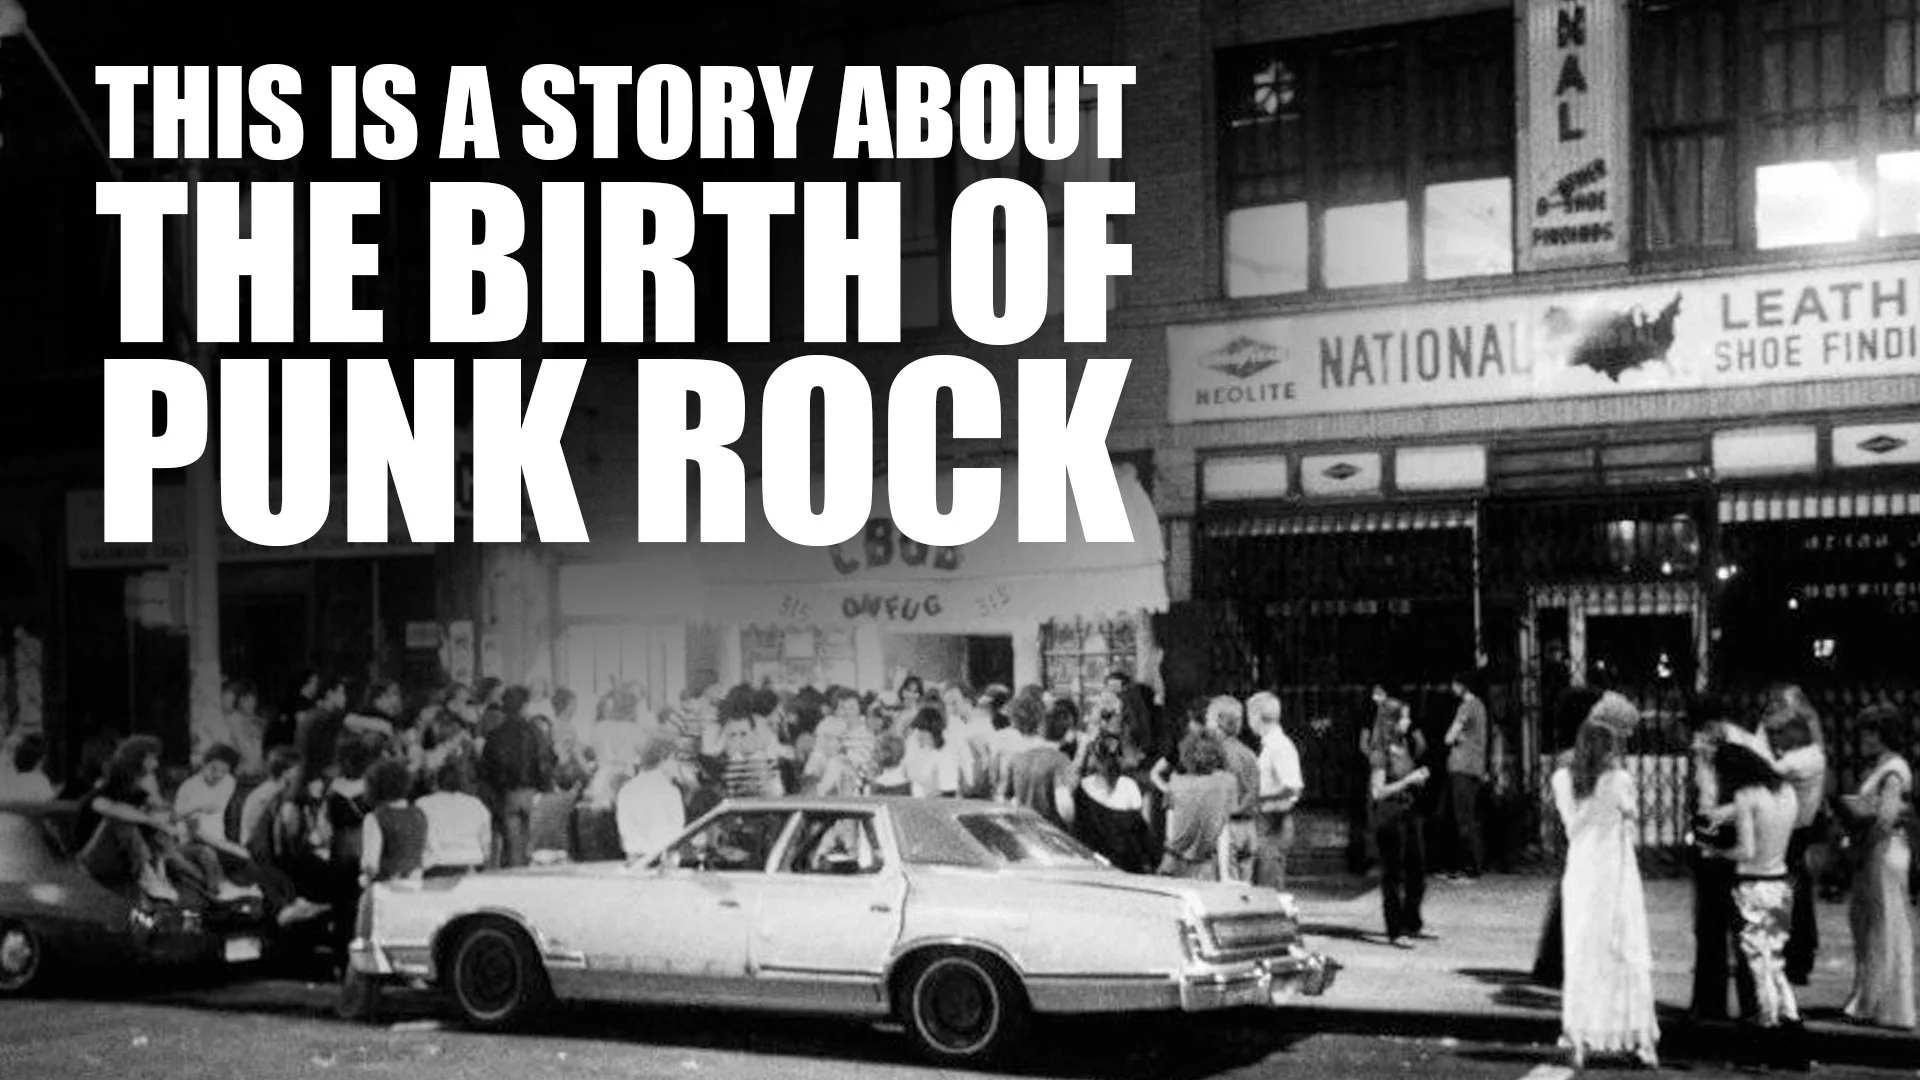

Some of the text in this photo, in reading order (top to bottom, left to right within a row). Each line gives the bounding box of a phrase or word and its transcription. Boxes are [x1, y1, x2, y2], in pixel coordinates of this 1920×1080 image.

[1556, 0, 1601, 143] NAL
[1721, 278, 1906, 331] LEATH
[1319, 321, 1533, 389] NATIONAL
[1715, 325, 1916, 372] SHOE FINDI
[1195, 382, 1297, 405] NEOLITE
